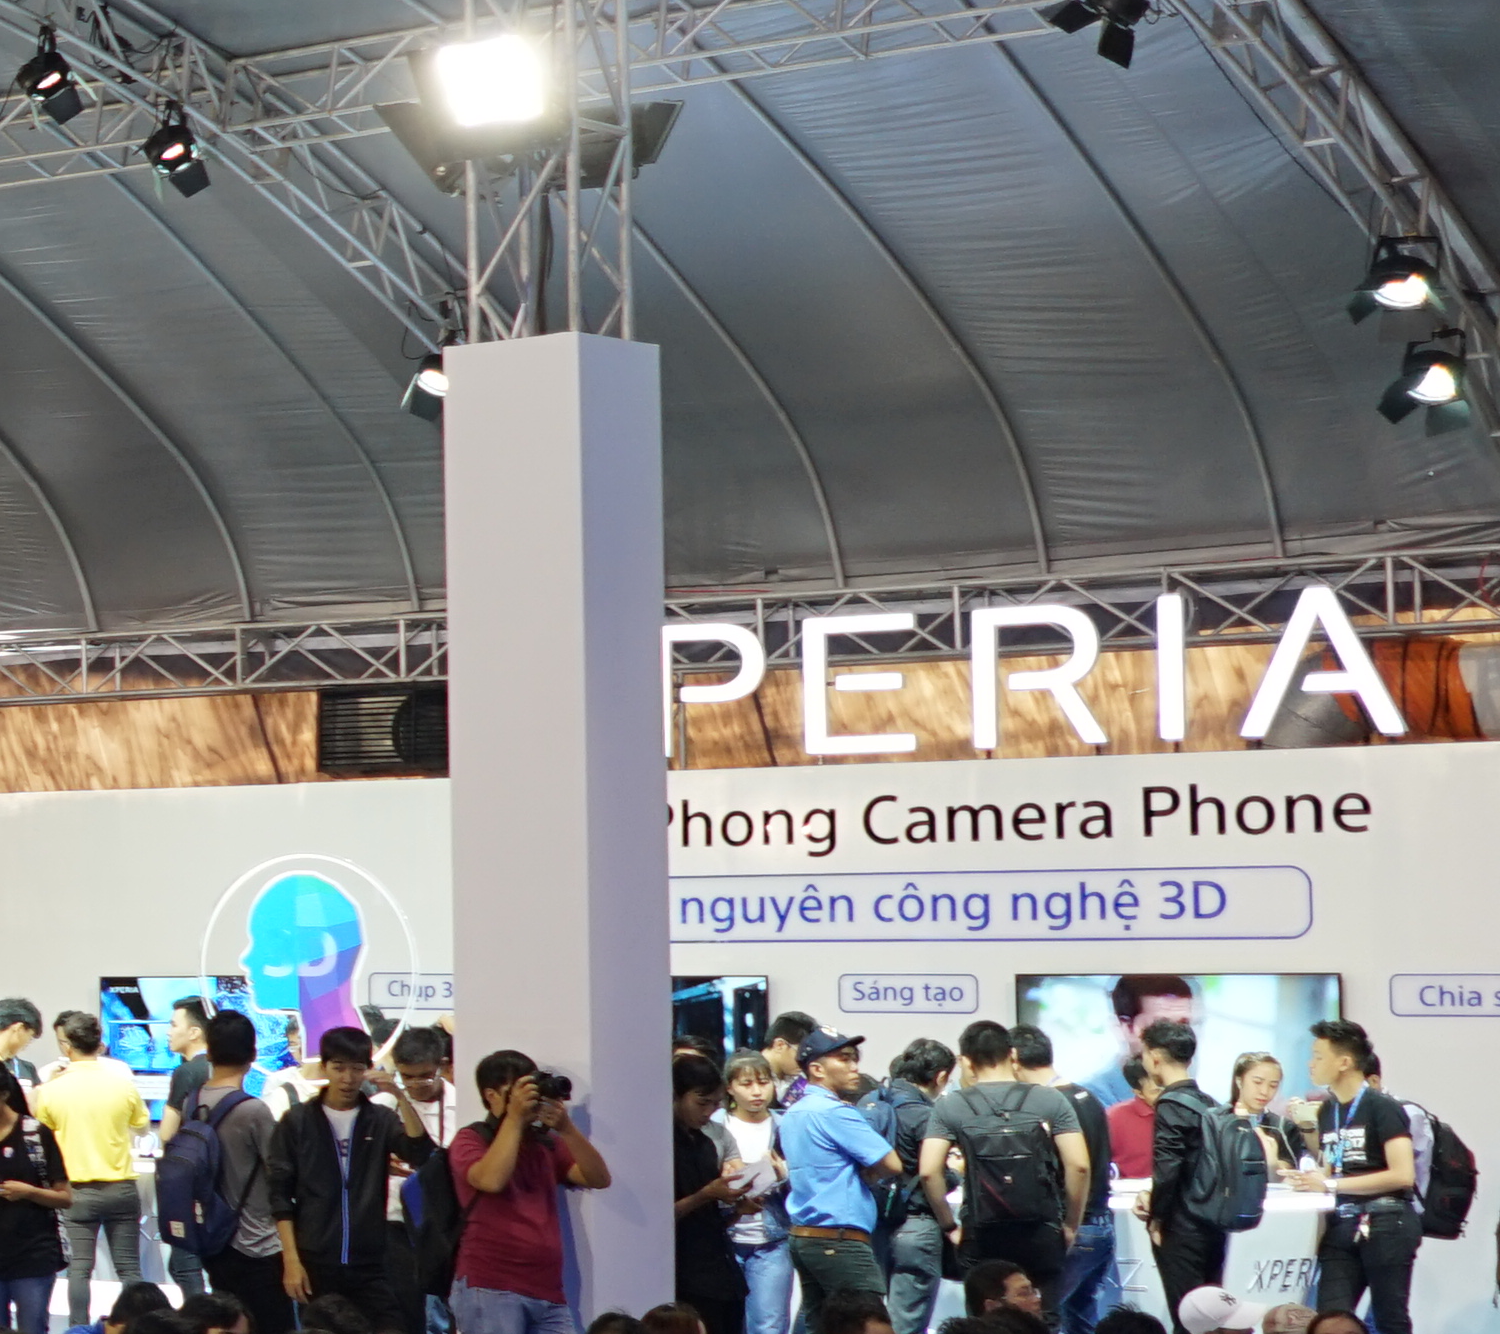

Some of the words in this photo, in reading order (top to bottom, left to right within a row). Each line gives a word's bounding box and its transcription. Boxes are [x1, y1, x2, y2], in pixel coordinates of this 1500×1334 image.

[667, 799, 837, 858] hong
[861, 794, 1114, 845] Camera
[1141, 782, 1373, 838] Phone
[679, 883, 856, 934] nguyên
[872, 881, 991, 932] công
[1010, 878, 1141, 931] nghệ
[1157, 879, 1228, 921] 3D
[852, 980, 914, 1007] Sáng
[922, 983, 965, 1007] tạo
[1419, 984, 1483, 1008] Chia
